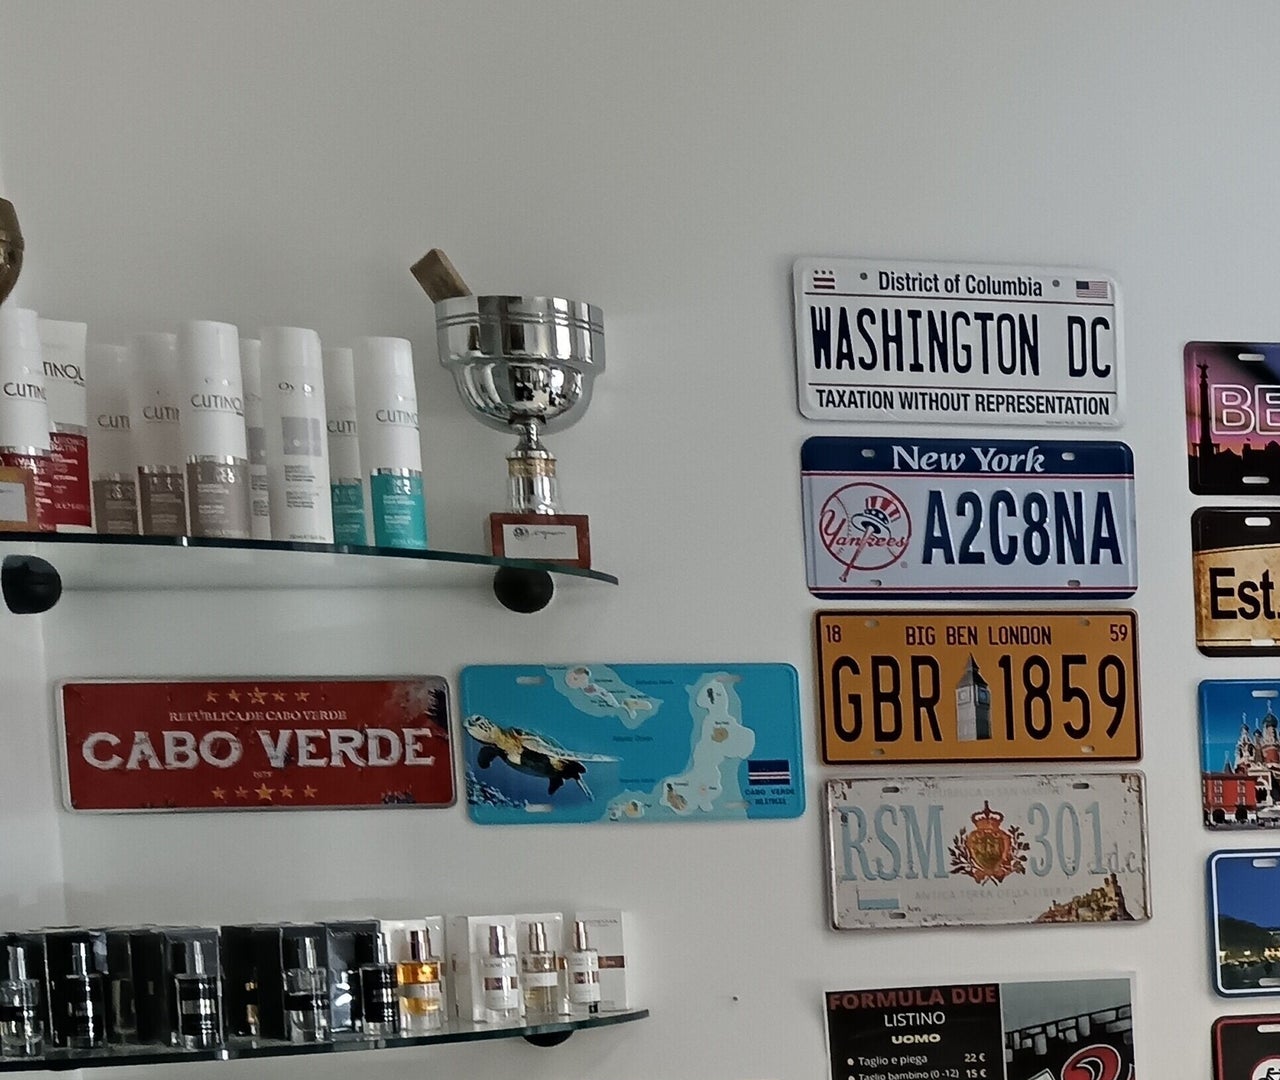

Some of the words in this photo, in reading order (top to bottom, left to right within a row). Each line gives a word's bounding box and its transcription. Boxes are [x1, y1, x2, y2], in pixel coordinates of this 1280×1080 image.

[878, 271, 939, 293] District
[945, 272, 960, 293] of
[965, 275, 1043, 297] Columbia
[810, 305, 1040, 376] WASHINGTON
[1067, 315, 1111, 378] DC
[816, 389, 894, 409] TAXATION
[898, 391, 971, 412] WITHOUT
[975, 394, 1110, 416] REPRESENTATION
[892, 445, 966, 471] New
[972, 447, 1046, 472] York
[921, 489, 1124, 565] A2C8NA
[826, 625, 842, 643] 18
[906, 626, 936, 645] BIG
[947, 626, 978, 645] BEN
[989, 626, 1051, 645] LONDON
[1110, 624, 1128, 642] 59
[831, 655, 943, 743] GBR
[998, 654, 1126, 740] 1859
[82, 730, 243, 771] CABO
[256, 727, 435, 768] VERDE
[839, 804, 949, 881] RSM
[1027, 801, 1107, 880] 301
[830, 989, 945, 1010] FORMULA
[952, 987, 997, 1004] DUE
[884, 1011, 946, 1027] LISTINO
[891, 1034, 941, 1044] UOMO
[858, 1056, 888, 1068] Taglio
[900, 1056, 928, 1066] piega
[888, 1071, 929, 1080] bambino
